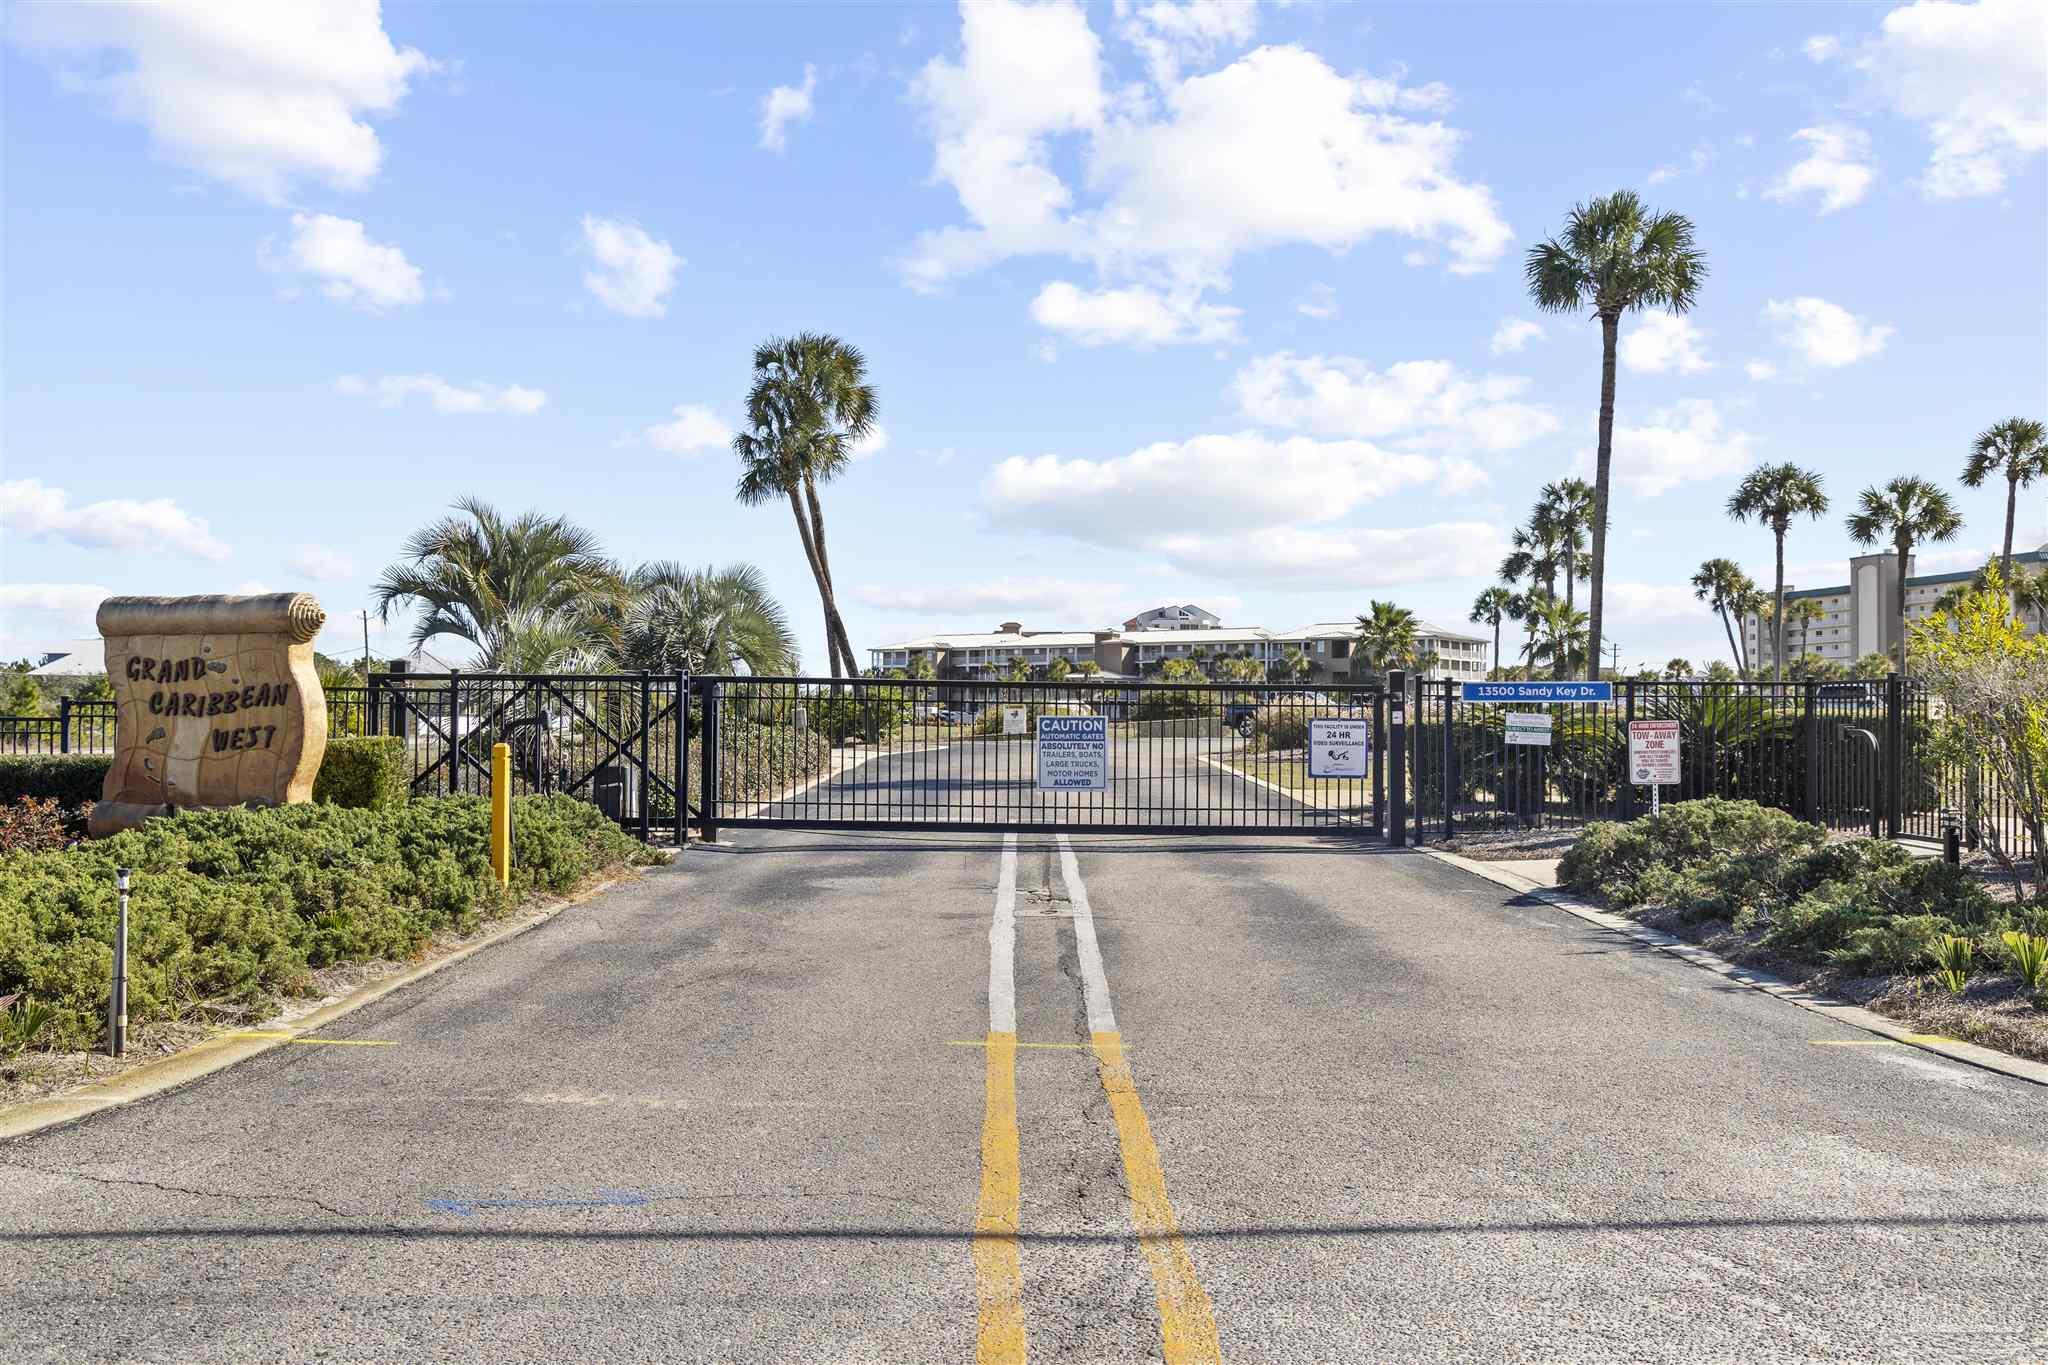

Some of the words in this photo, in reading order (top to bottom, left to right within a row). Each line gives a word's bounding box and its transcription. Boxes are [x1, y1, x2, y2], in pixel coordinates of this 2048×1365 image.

[126, 655, 206, 684] GRAND
[1477, 686, 1515, 696] 13500
[1518, 686, 1553, 698] Sandy
[1556, 686, 1577, 698] Key
[1580, 686, 1596, 696] Dr.
[148, 682, 290, 718] CARIBBEAN
[1041, 719, 1103, 732] CAUTION
[212, 725, 277, 752] WEST
[1326, 731, 1337, 739] 24
[1339, 731, 1351, 739] HR
[1632, 731, 1677, 740] TOW-AWAY
[1041, 742, 1091, 750] ABSOLUTELY
[1092, 742, 1104, 750] NO
[1644, 740, 1665, 749] ZONE
[1046, 760, 1069, 768] LARGE
